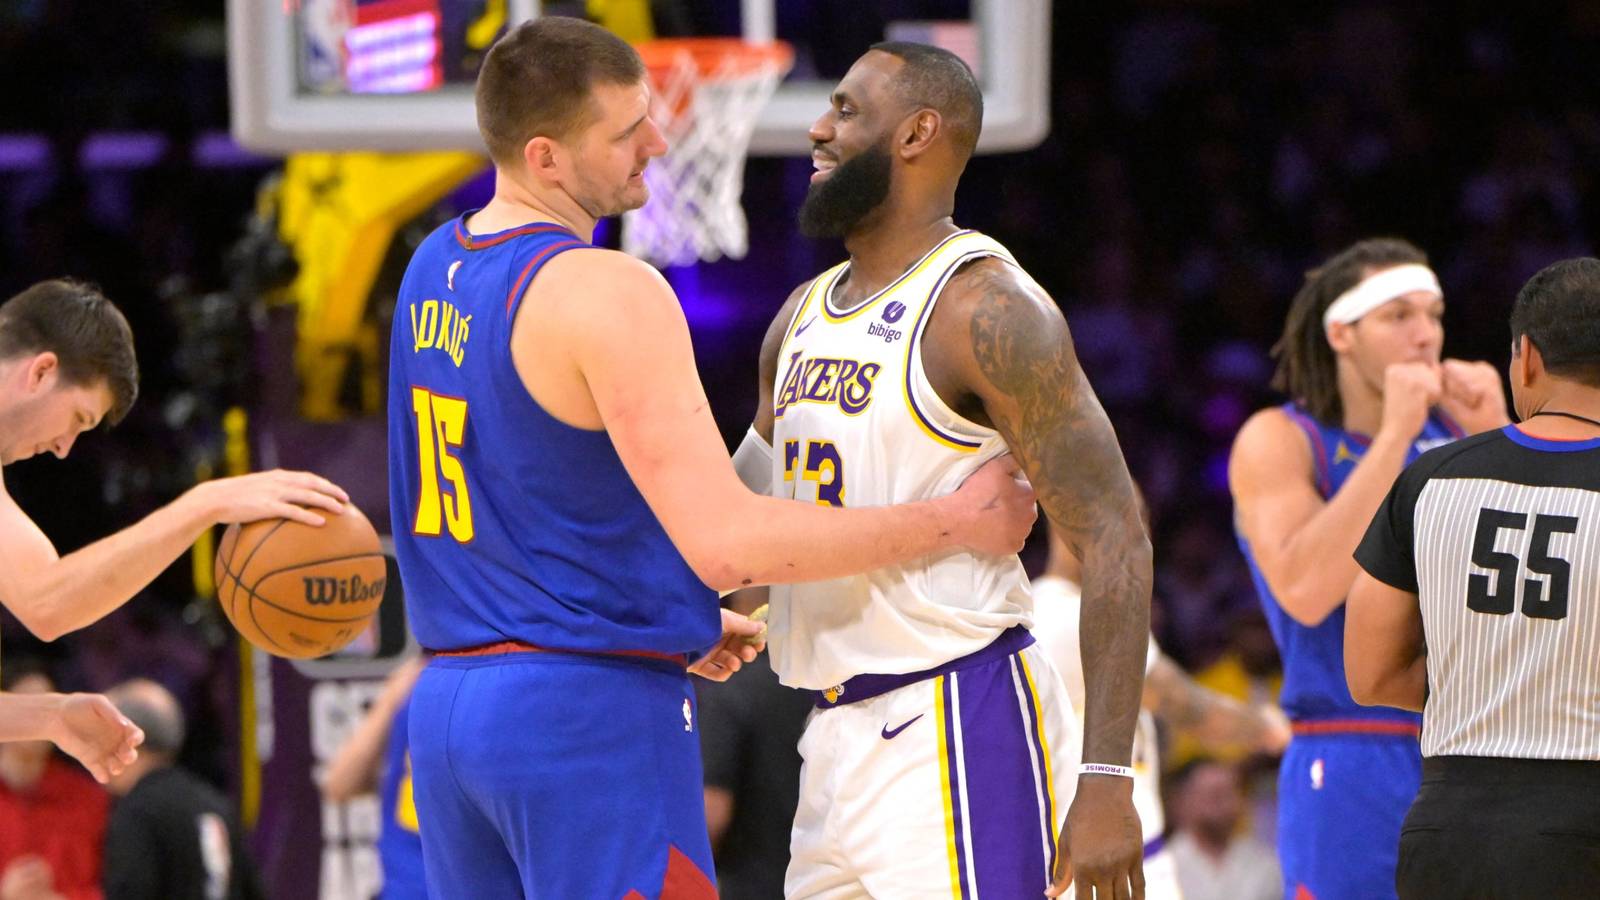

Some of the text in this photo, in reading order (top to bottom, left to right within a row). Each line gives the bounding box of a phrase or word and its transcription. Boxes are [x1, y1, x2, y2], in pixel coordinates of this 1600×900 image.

[409, 299, 472, 368] JOKIĆ
[867, 322, 902, 343] bibigo
[774, 350, 881, 417] LAKERS
[411, 385, 475, 544] 15
[1466, 507, 1579, 621] 55
[1085, 764, 1121, 774] PROMISE
